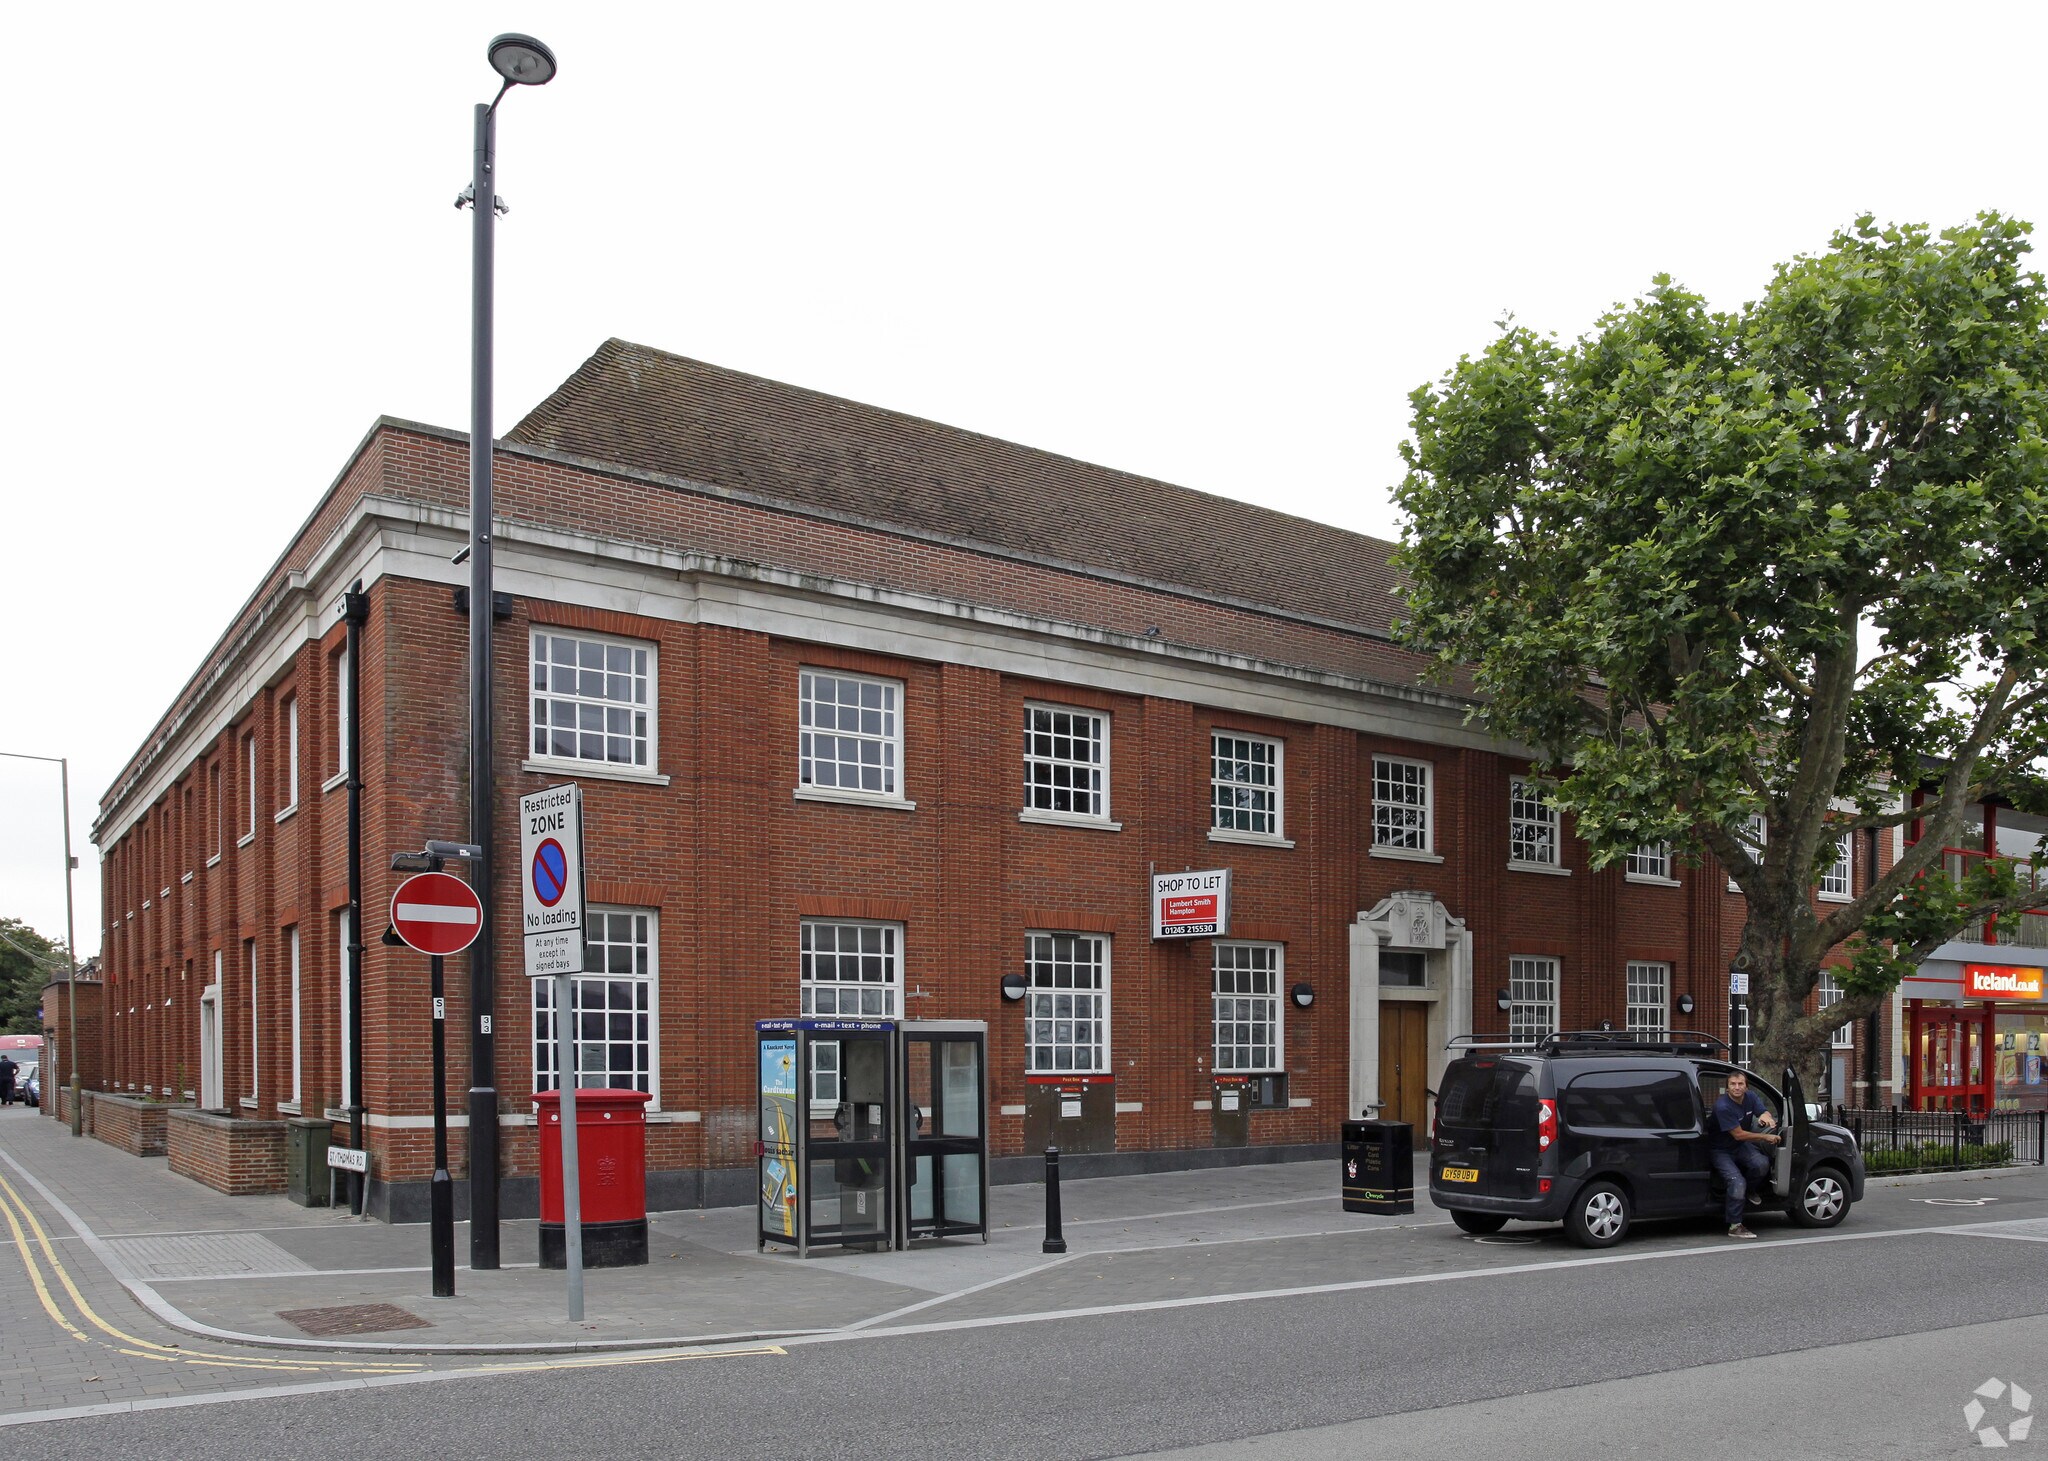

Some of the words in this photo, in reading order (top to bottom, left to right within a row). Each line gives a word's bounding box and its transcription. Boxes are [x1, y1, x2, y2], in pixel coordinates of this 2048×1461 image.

[525, 790, 571, 814] Restricted
[531, 811, 565, 835] ZONE
[1158, 879, 1184, 893] SHOP
[1187, 877, 1200, 890] TO
[1204, 876, 1221, 889] LET
[1169, 900, 1193, 908] Lambert
[1194, 898, 1211, 906] Smith
[1169, 907, 1195, 915] Hampton
[527, 913, 540, 927] No
[542, 910, 576, 926] loading
[1165, 926, 1185, 934] 01245
[1187, 925, 1213, 933] 215530
[535, 938, 543, 947] At
[544, 939, 554, 947] any
[555, 936, 569, 945] time
[539, 950, 559, 959] except
[536, 960, 555, 971] signed
[555, 959, 570, 969] bays
[2004, 1034, 2015, 1051] £2
[2028, 1034, 2040, 1051] £2
[1444, 1169, 1461, 1179] GY58
[1461, 1170, 1476, 1180] UBV
